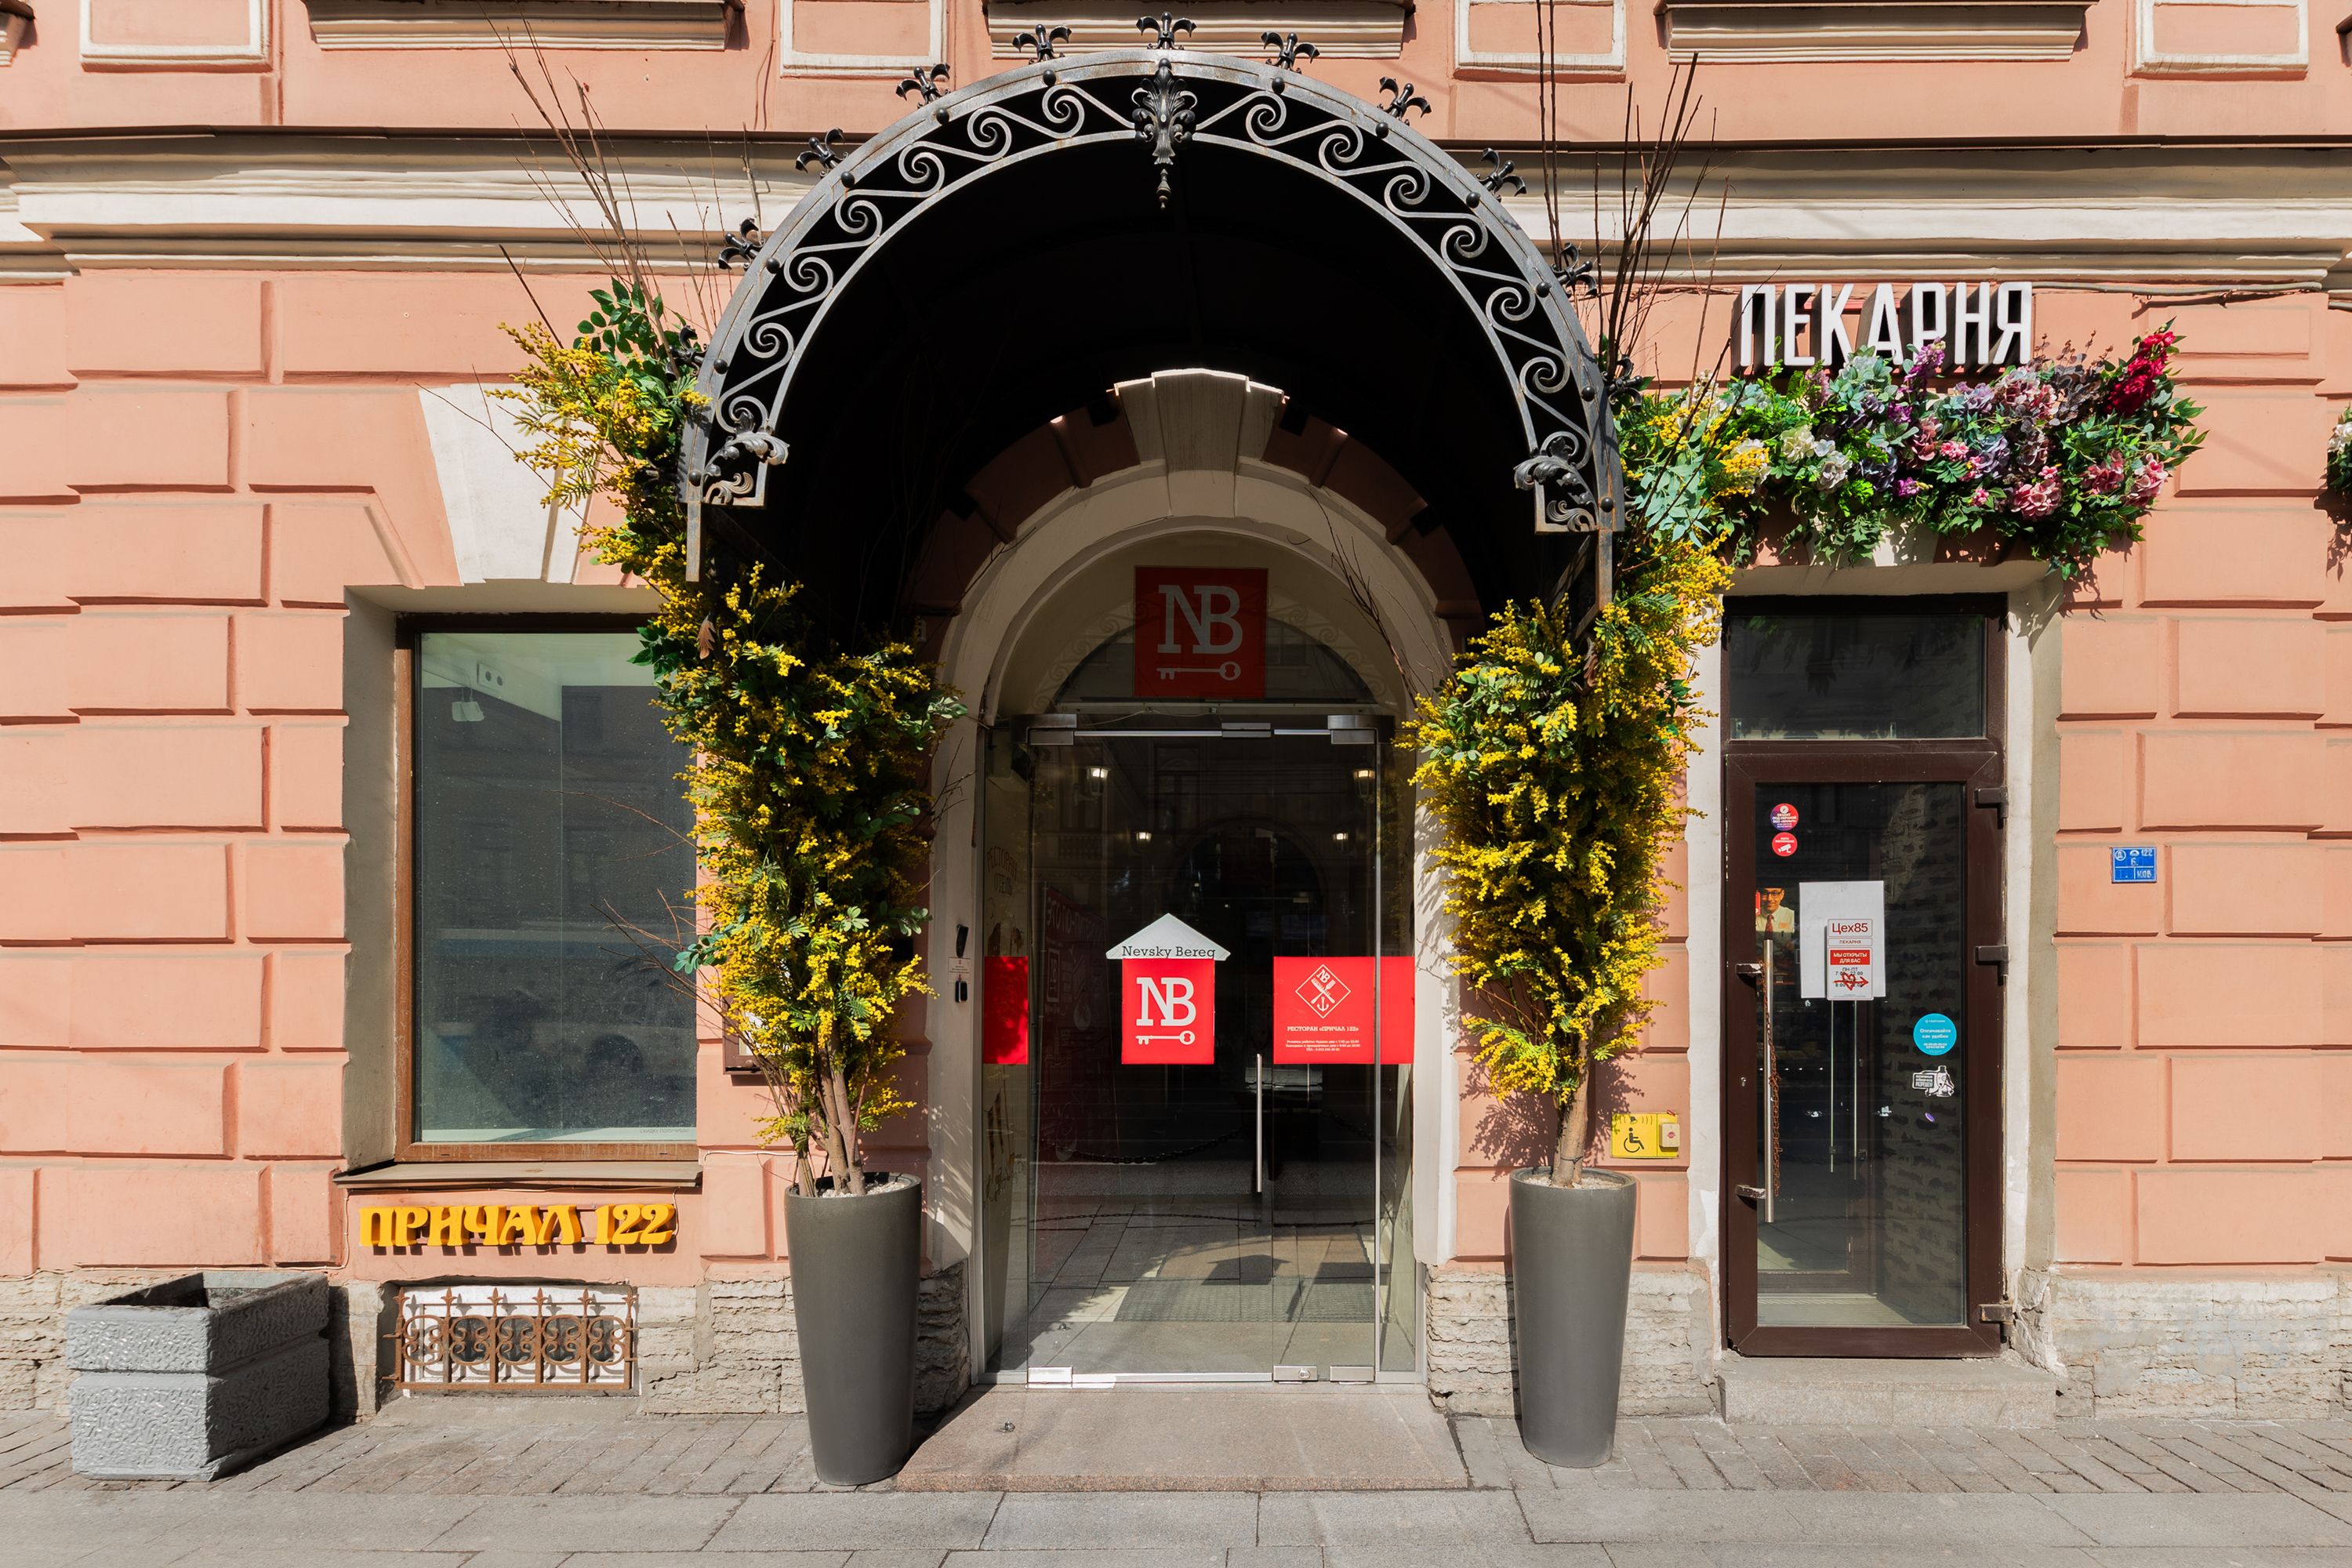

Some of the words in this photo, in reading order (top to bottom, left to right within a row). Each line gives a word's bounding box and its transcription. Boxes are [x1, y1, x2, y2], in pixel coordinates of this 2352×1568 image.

[1739, 281, 2033, 367] ПЕКАРНЯ
[1157, 584, 1243, 655] NB
[1832, 923, 1868, 935] Цех85
[1122, 946, 1172, 959] Nevsky
[1316, 969, 1330, 983] NB
[1136, 977, 1196, 1027] NB
[359, 1204, 583, 1247] ПРИЧАЛ
[594, 1203, 677, 1246] 122
